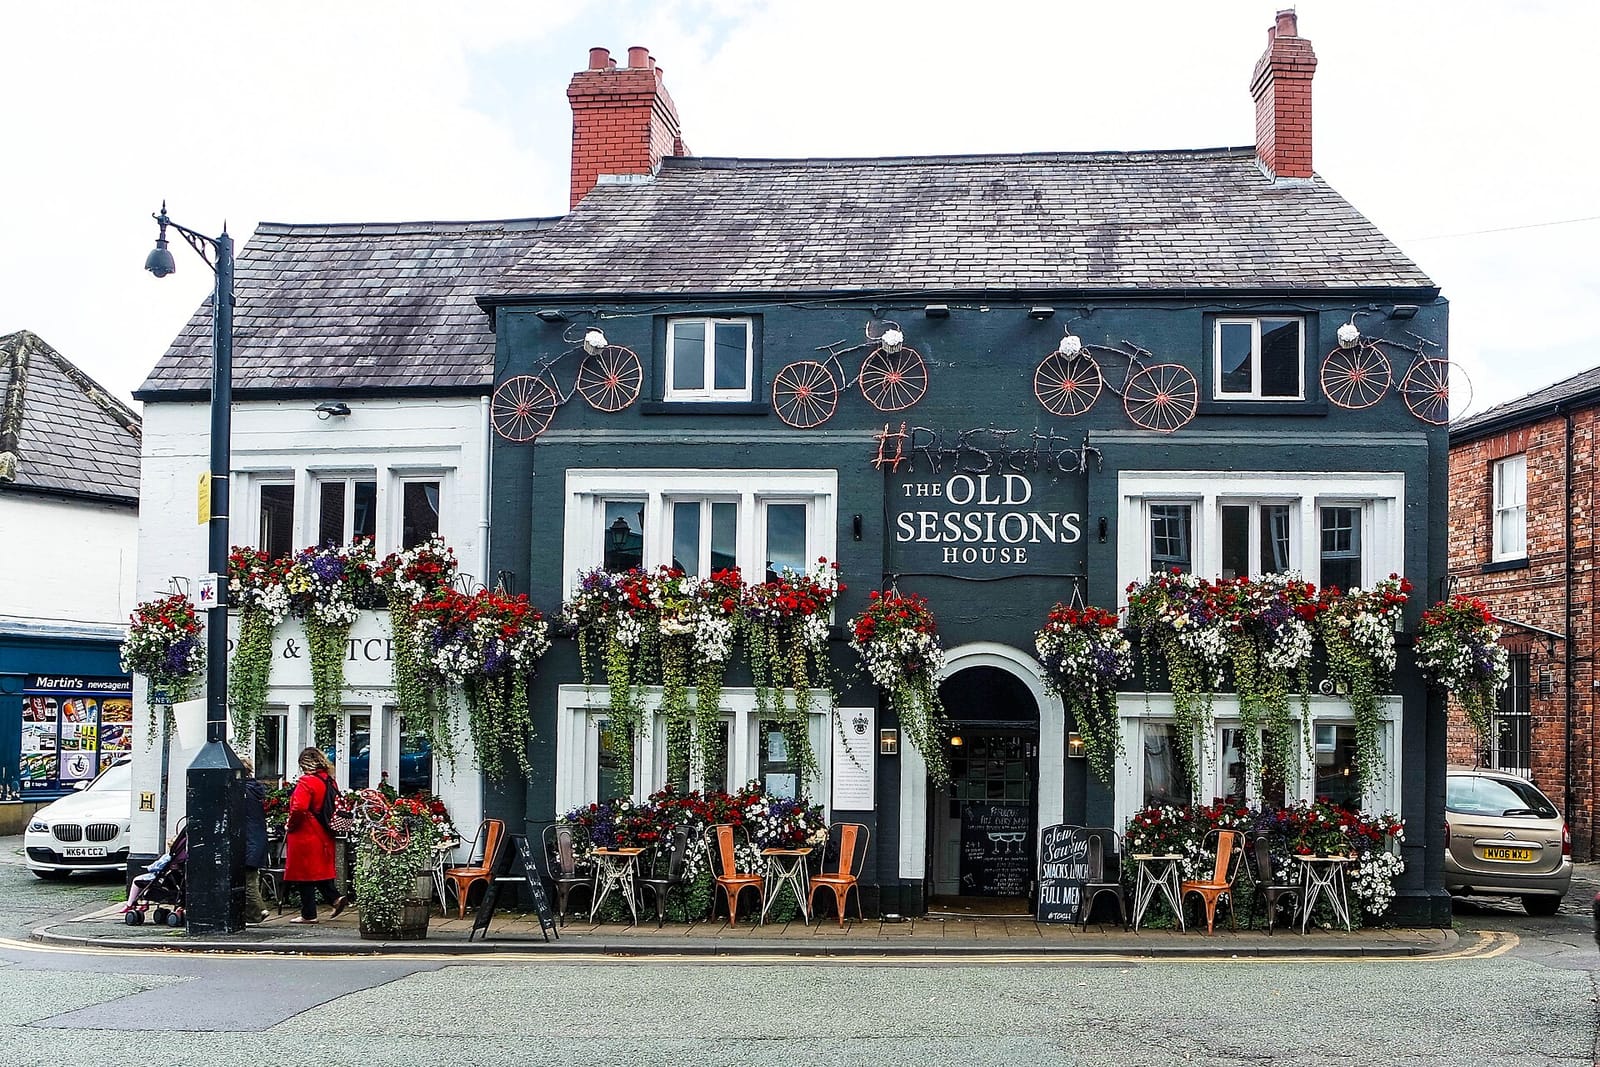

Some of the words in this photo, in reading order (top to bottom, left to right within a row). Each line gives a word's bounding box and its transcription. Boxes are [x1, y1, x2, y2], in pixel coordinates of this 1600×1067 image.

[902, 483, 942, 497] THE
[945, 474, 1032, 505] OLD
[896, 511, 1081, 544] SESSIONS
[942, 547, 1028, 564] HOUSE
[283, 638, 301, 659] &
[36, 677, 83, 689] Martin's
[87, 681, 130, 690] newsagent
[1041, 886, 1061, 904] FULL
[1063, 886, 1080, 905] MEN
